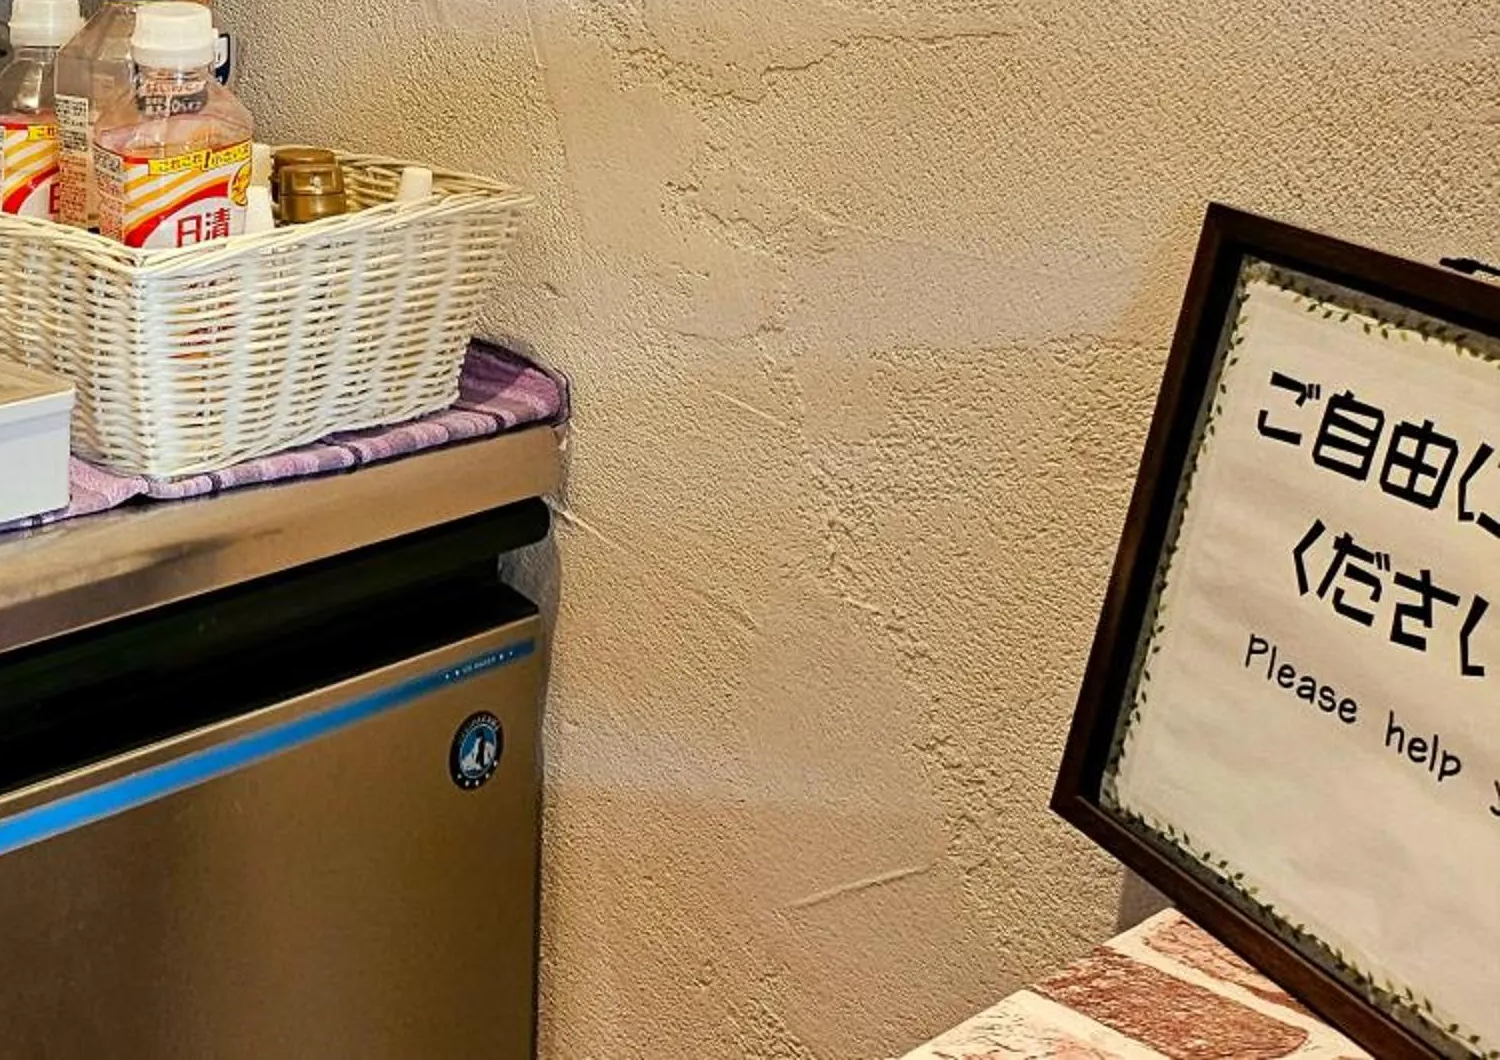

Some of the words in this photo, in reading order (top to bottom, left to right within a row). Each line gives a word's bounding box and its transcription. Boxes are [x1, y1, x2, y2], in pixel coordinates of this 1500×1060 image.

[177, 207, 230, 248] 日清
[1246, 633, 1357, 724] Please
[1385, 709, 1462, 782] help
